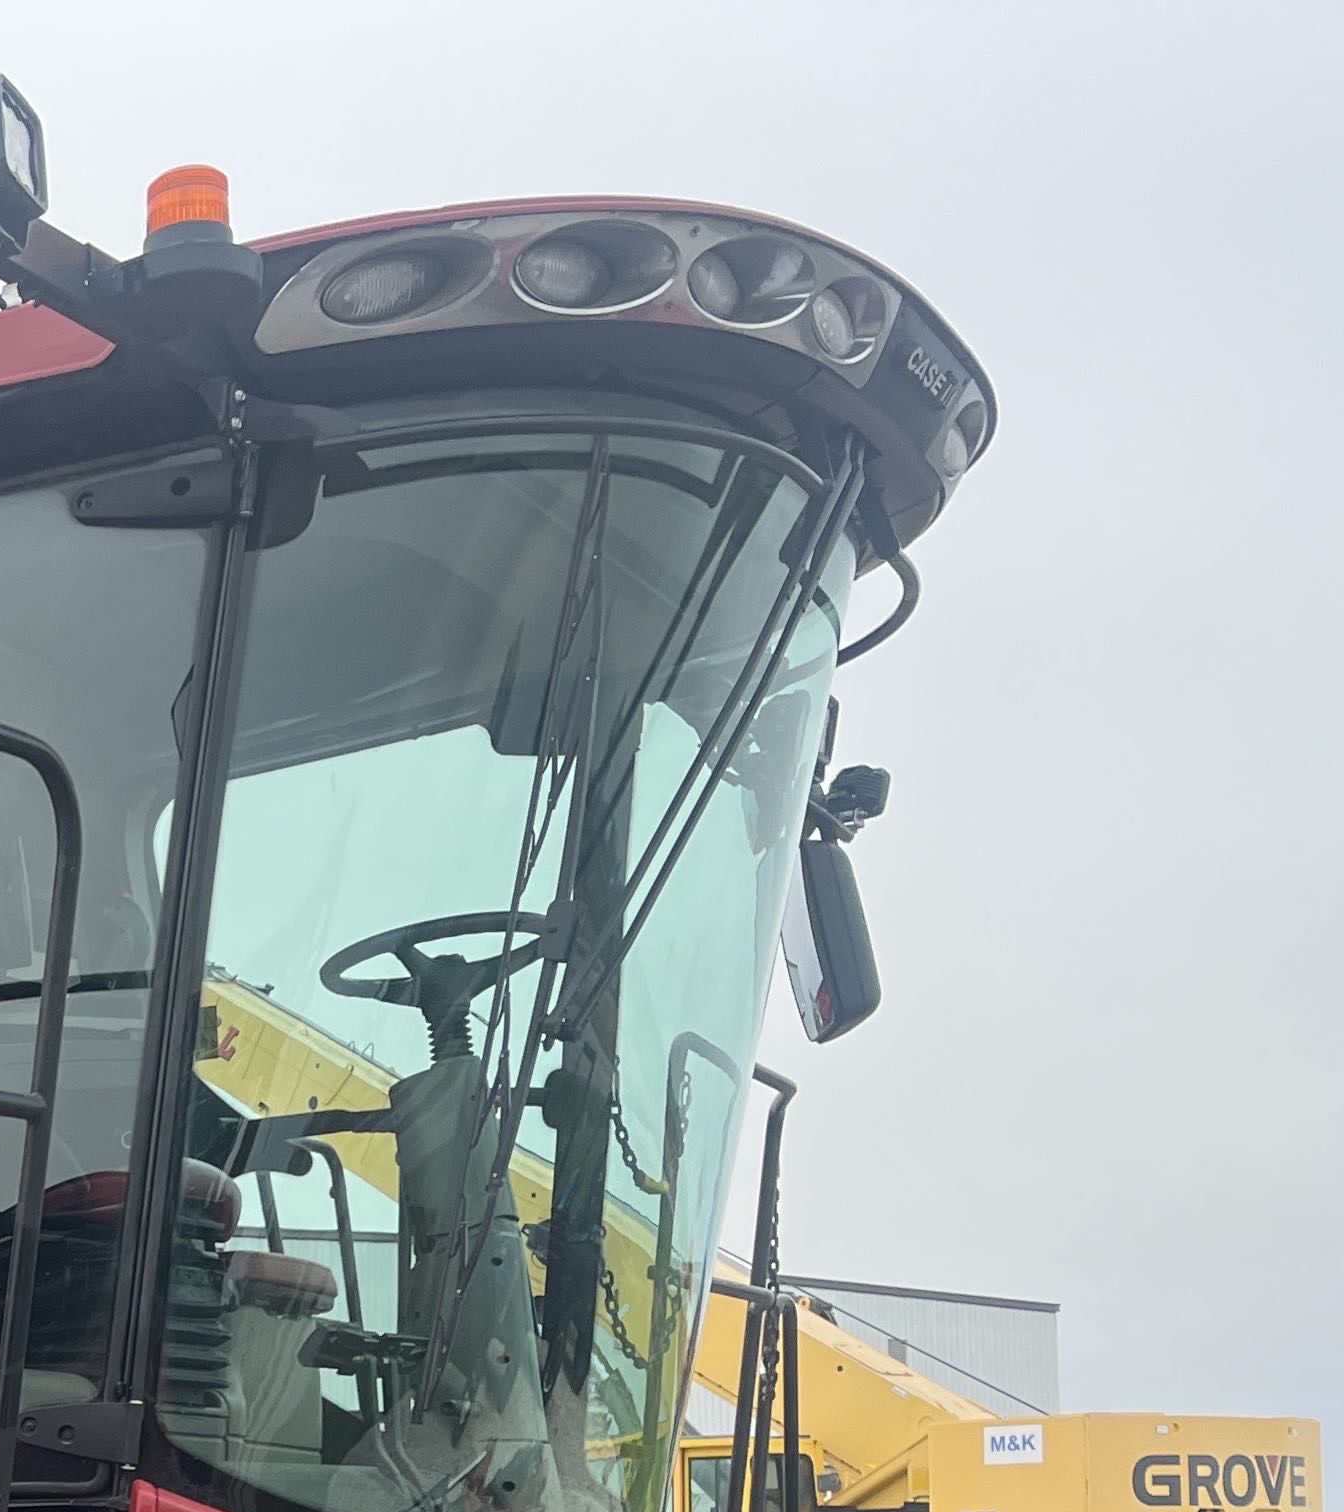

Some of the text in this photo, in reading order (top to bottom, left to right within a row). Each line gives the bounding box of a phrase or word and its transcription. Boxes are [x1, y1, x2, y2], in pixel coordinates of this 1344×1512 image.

[908, 347, 947, 396] CASE
[991, 1434, 1035, 1452] M&K
[1132, 1455, 1307, 1507] GROVE
